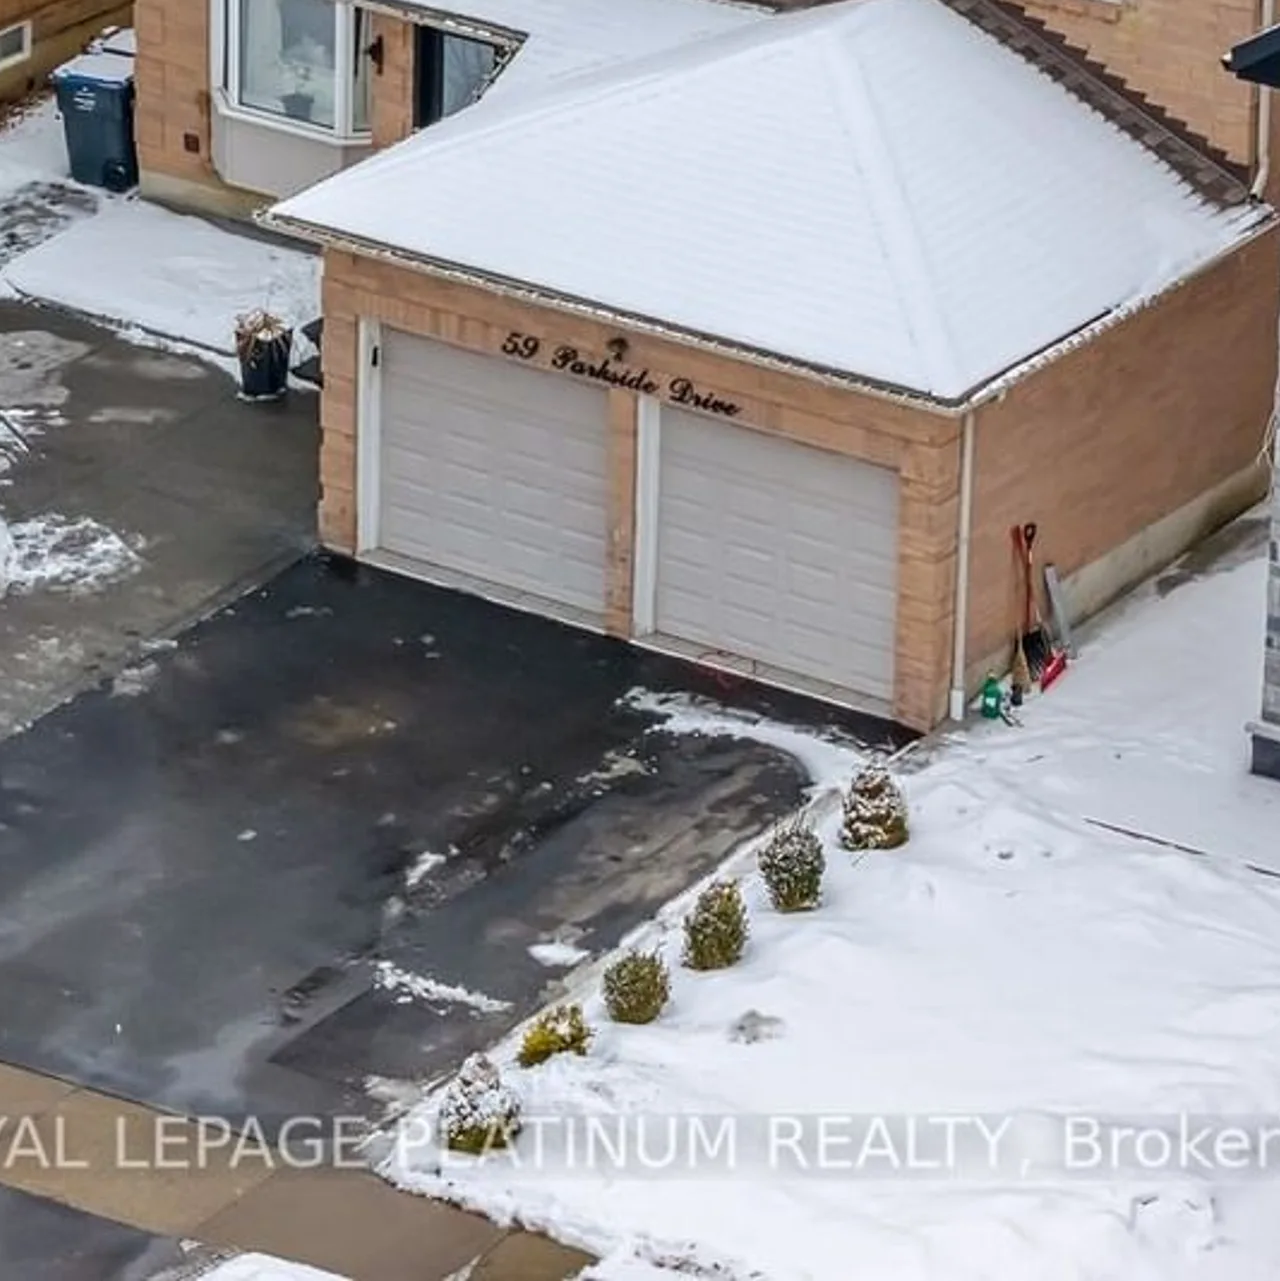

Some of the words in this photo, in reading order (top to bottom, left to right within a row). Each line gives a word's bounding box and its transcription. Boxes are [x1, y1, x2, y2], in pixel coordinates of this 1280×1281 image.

[501, 332, 540, 359] 59
[551, 345, 660, 394] Parkside
[668, 377, 743, 417] Drive
